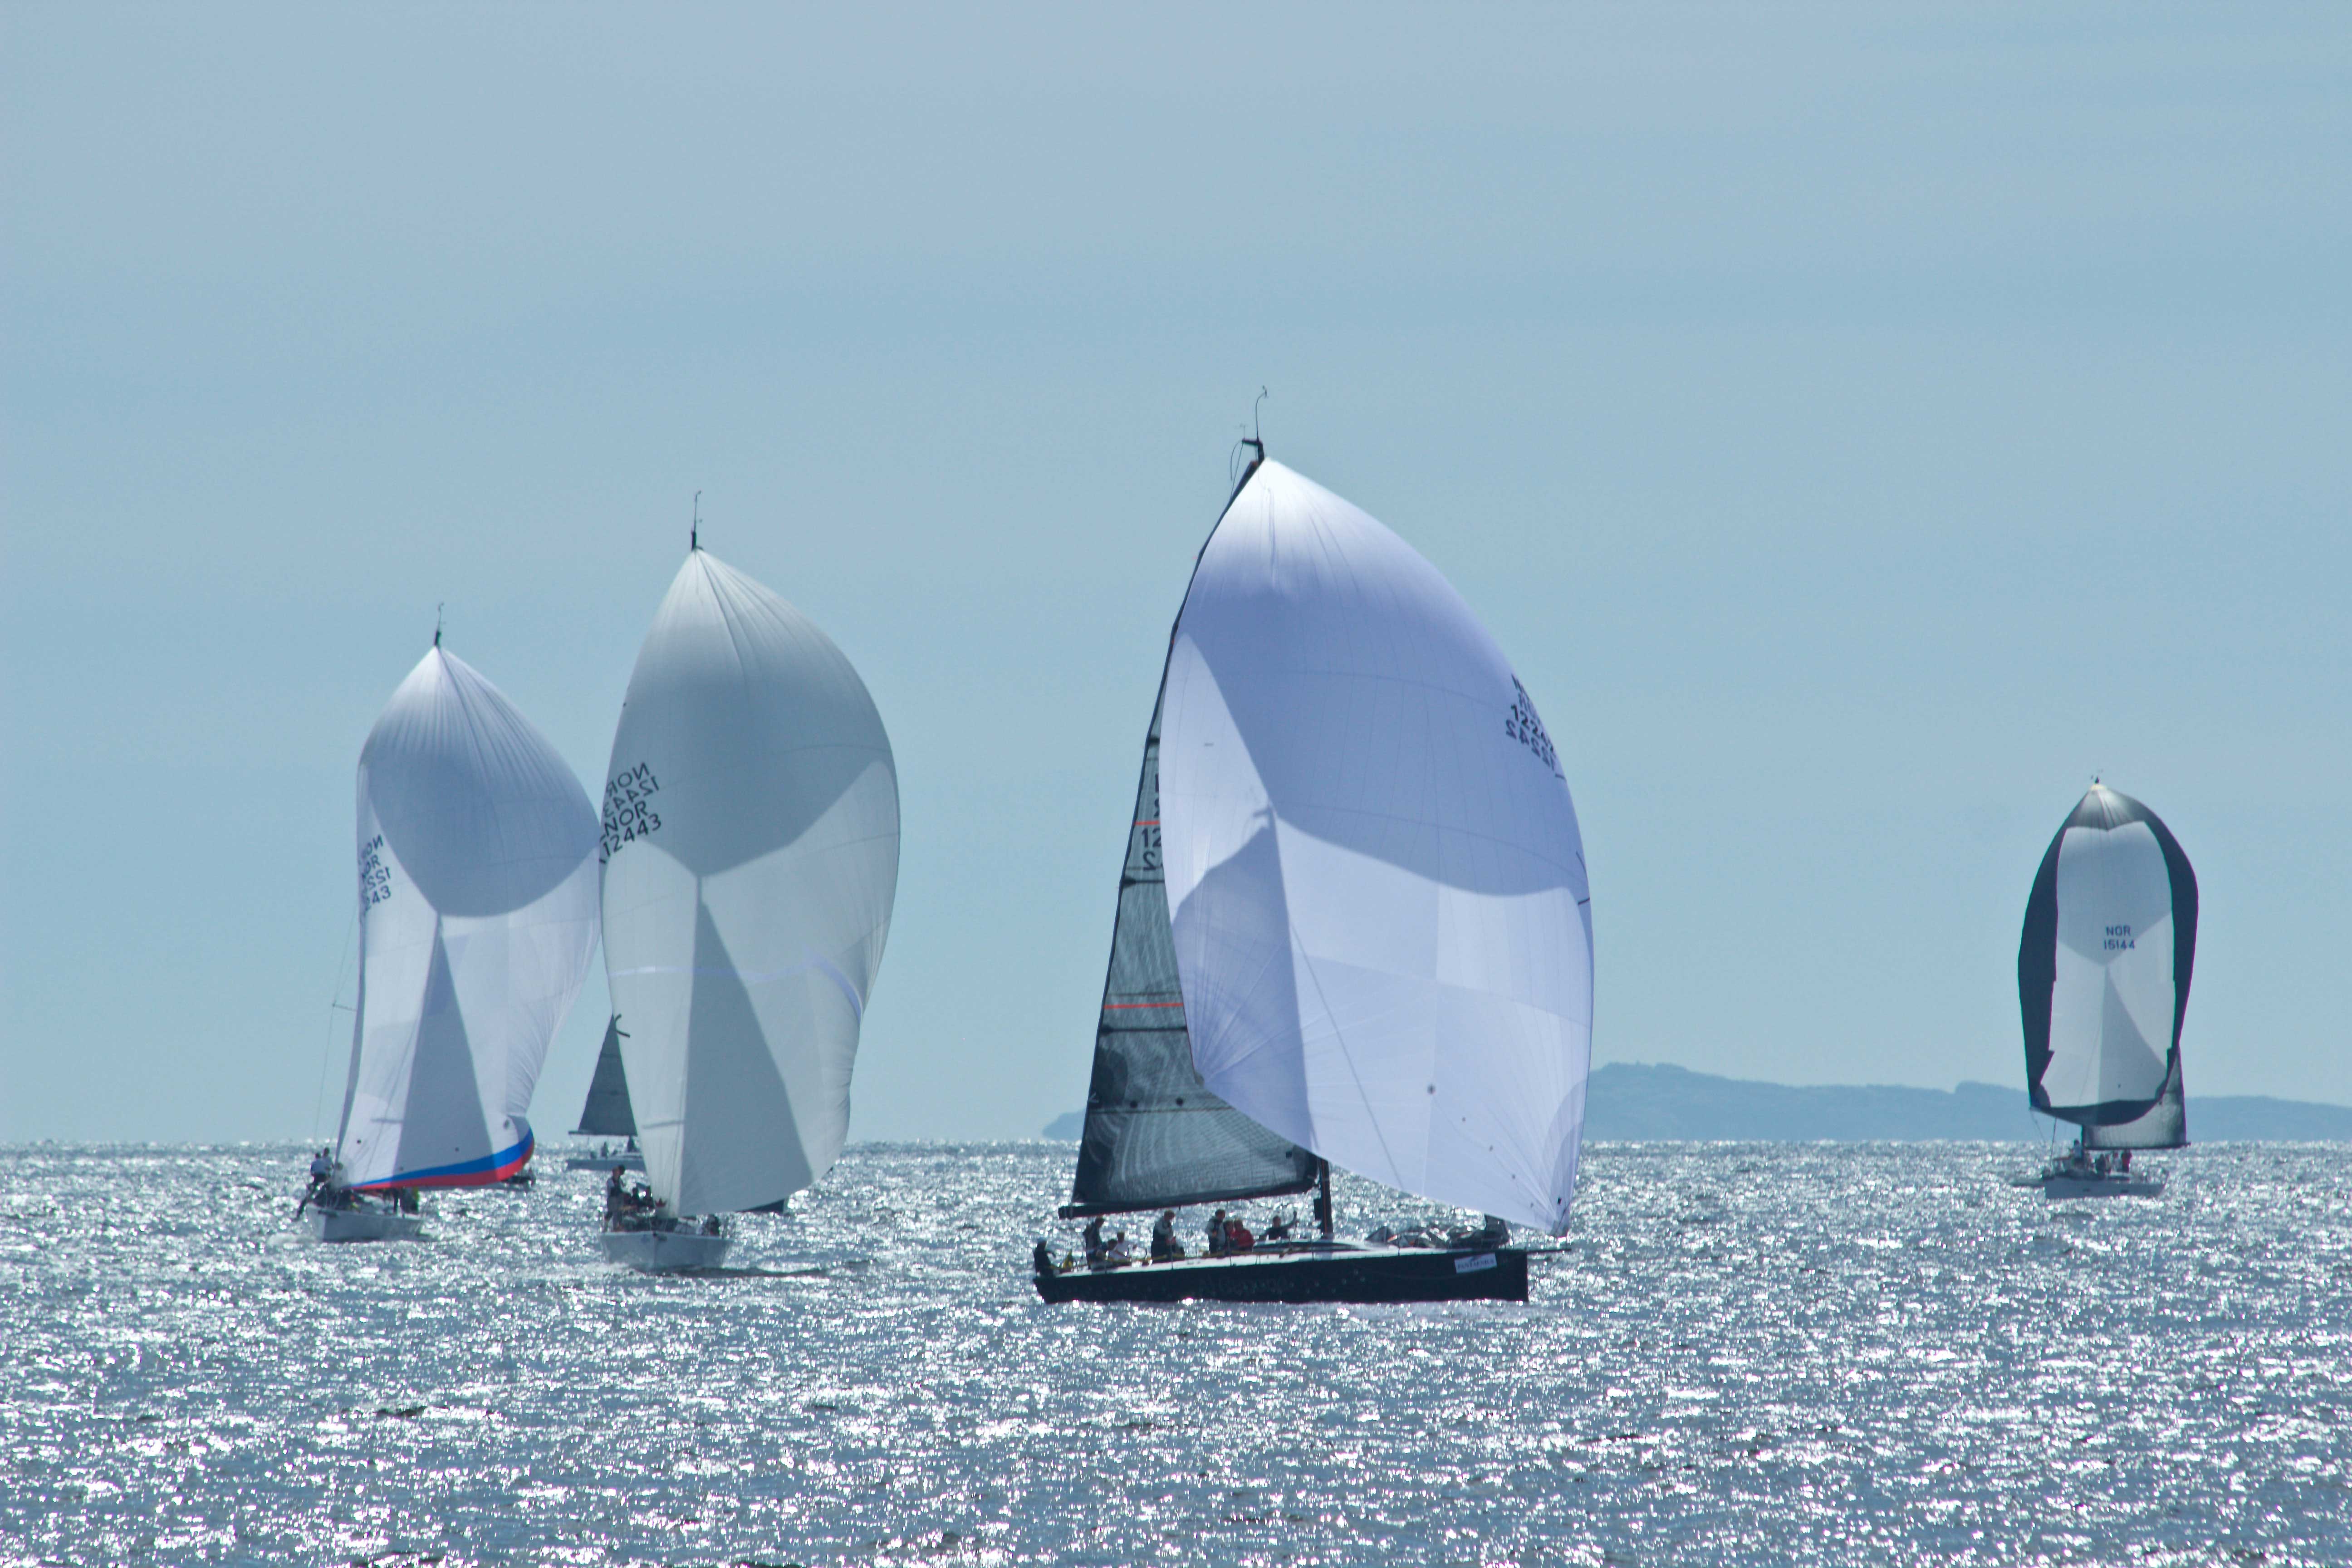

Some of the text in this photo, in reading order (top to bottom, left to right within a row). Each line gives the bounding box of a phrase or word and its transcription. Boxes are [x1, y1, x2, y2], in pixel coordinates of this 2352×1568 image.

[604, 800, 648, 837] NOR
[603, 813, 662, 857] 12443
[2106, 925, 2131, 937] NOR
[2103, 939, 2135, 951] 15144
